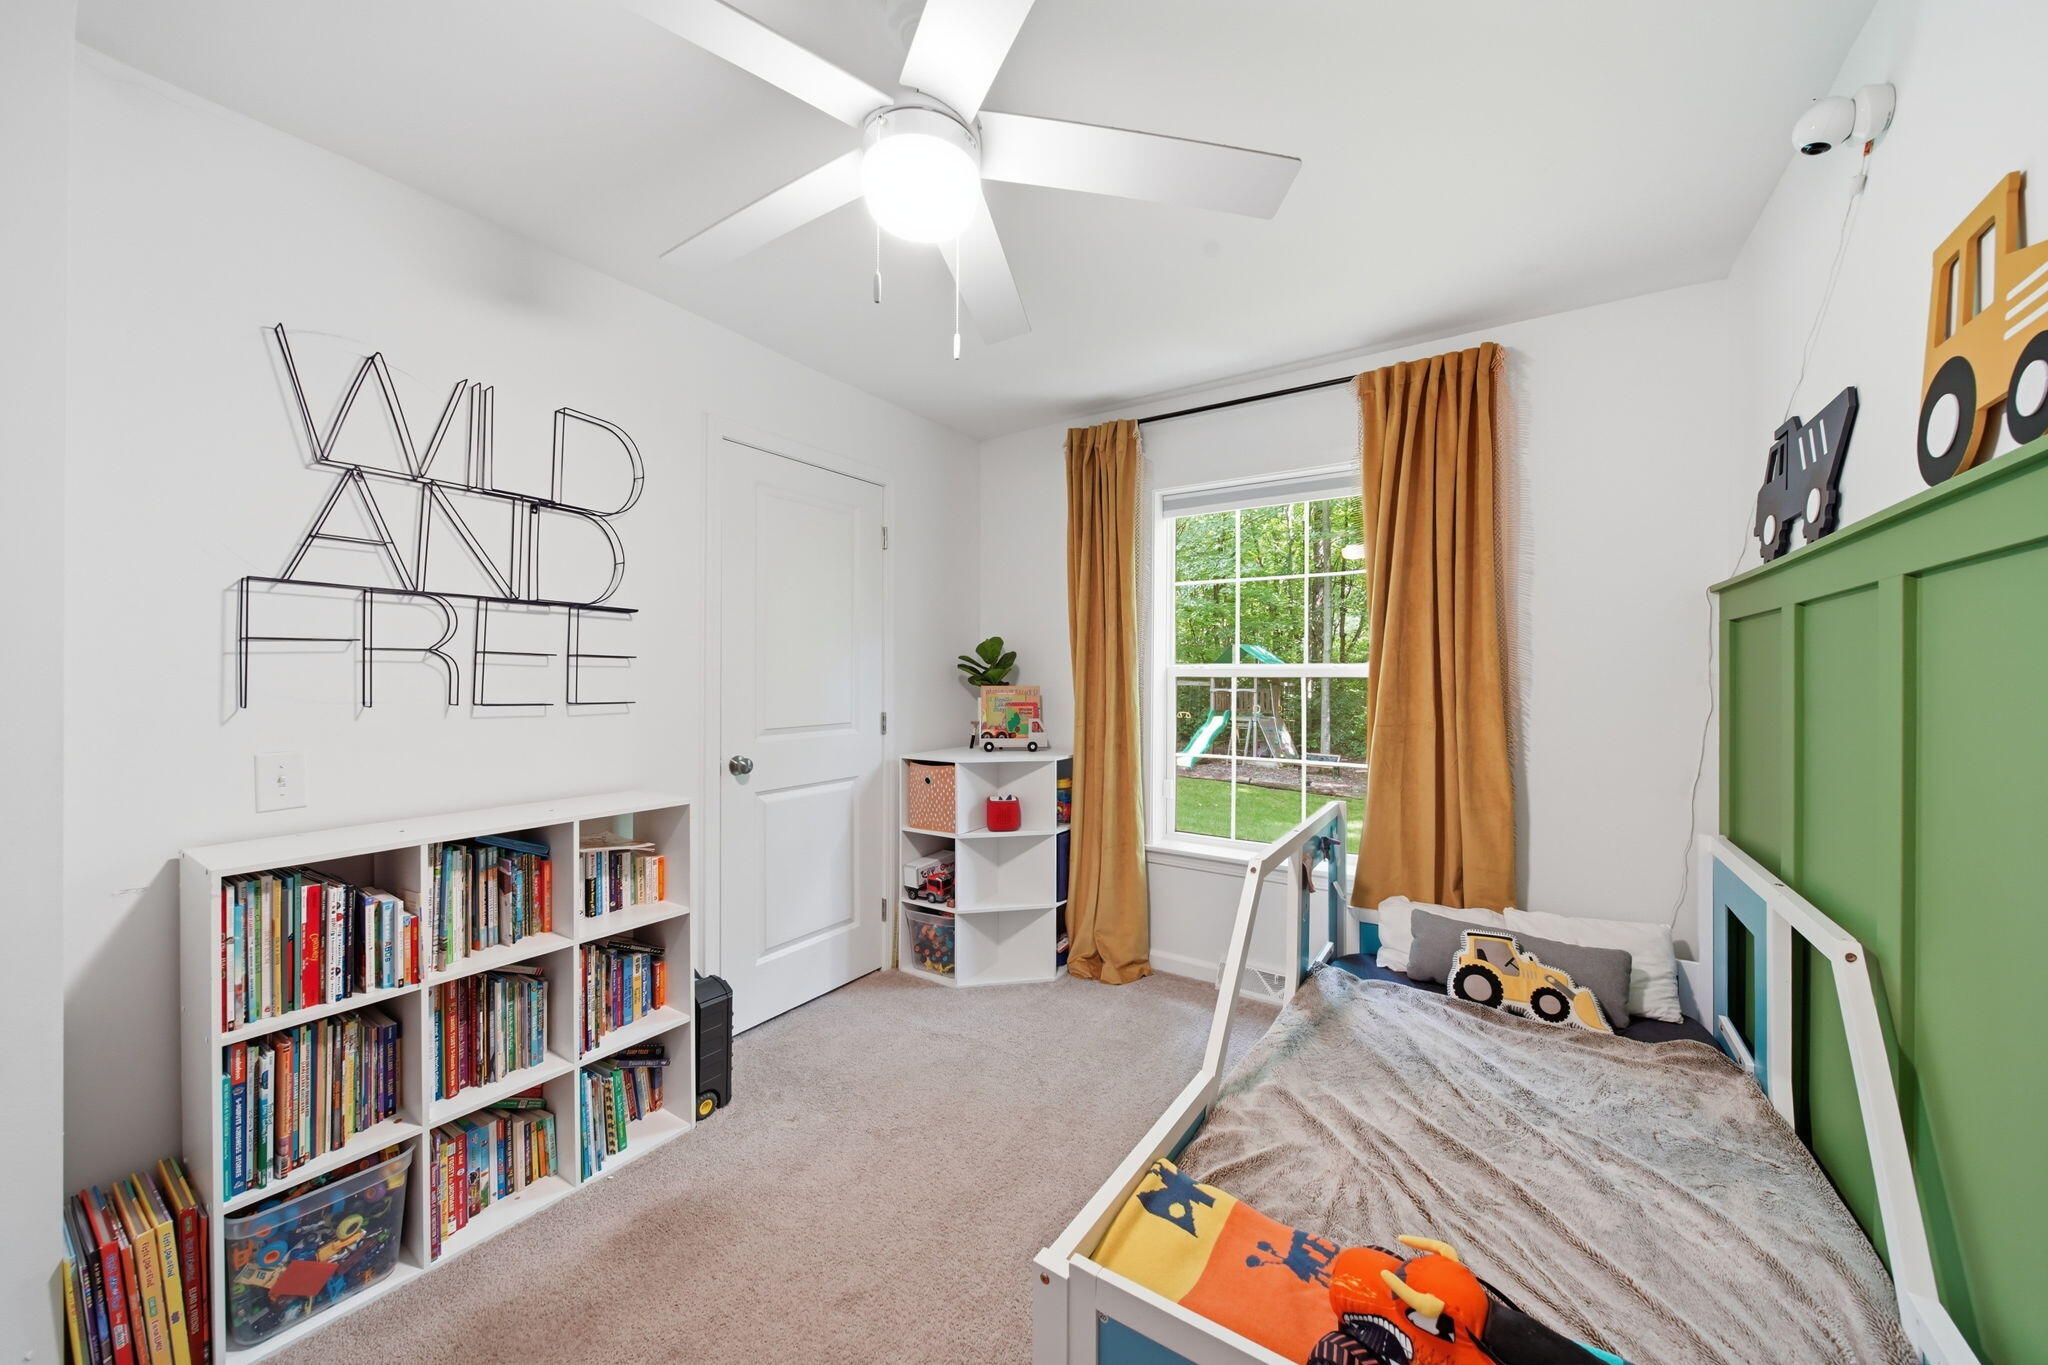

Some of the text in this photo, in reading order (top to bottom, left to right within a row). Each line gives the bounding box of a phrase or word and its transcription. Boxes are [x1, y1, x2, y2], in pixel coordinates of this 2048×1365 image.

[274, 322, 645, 517] WILD
[281, 464, 625, 608] AND
[239, 575, 639, 709] FREE
[166, 1264, 174, 1278] Find
